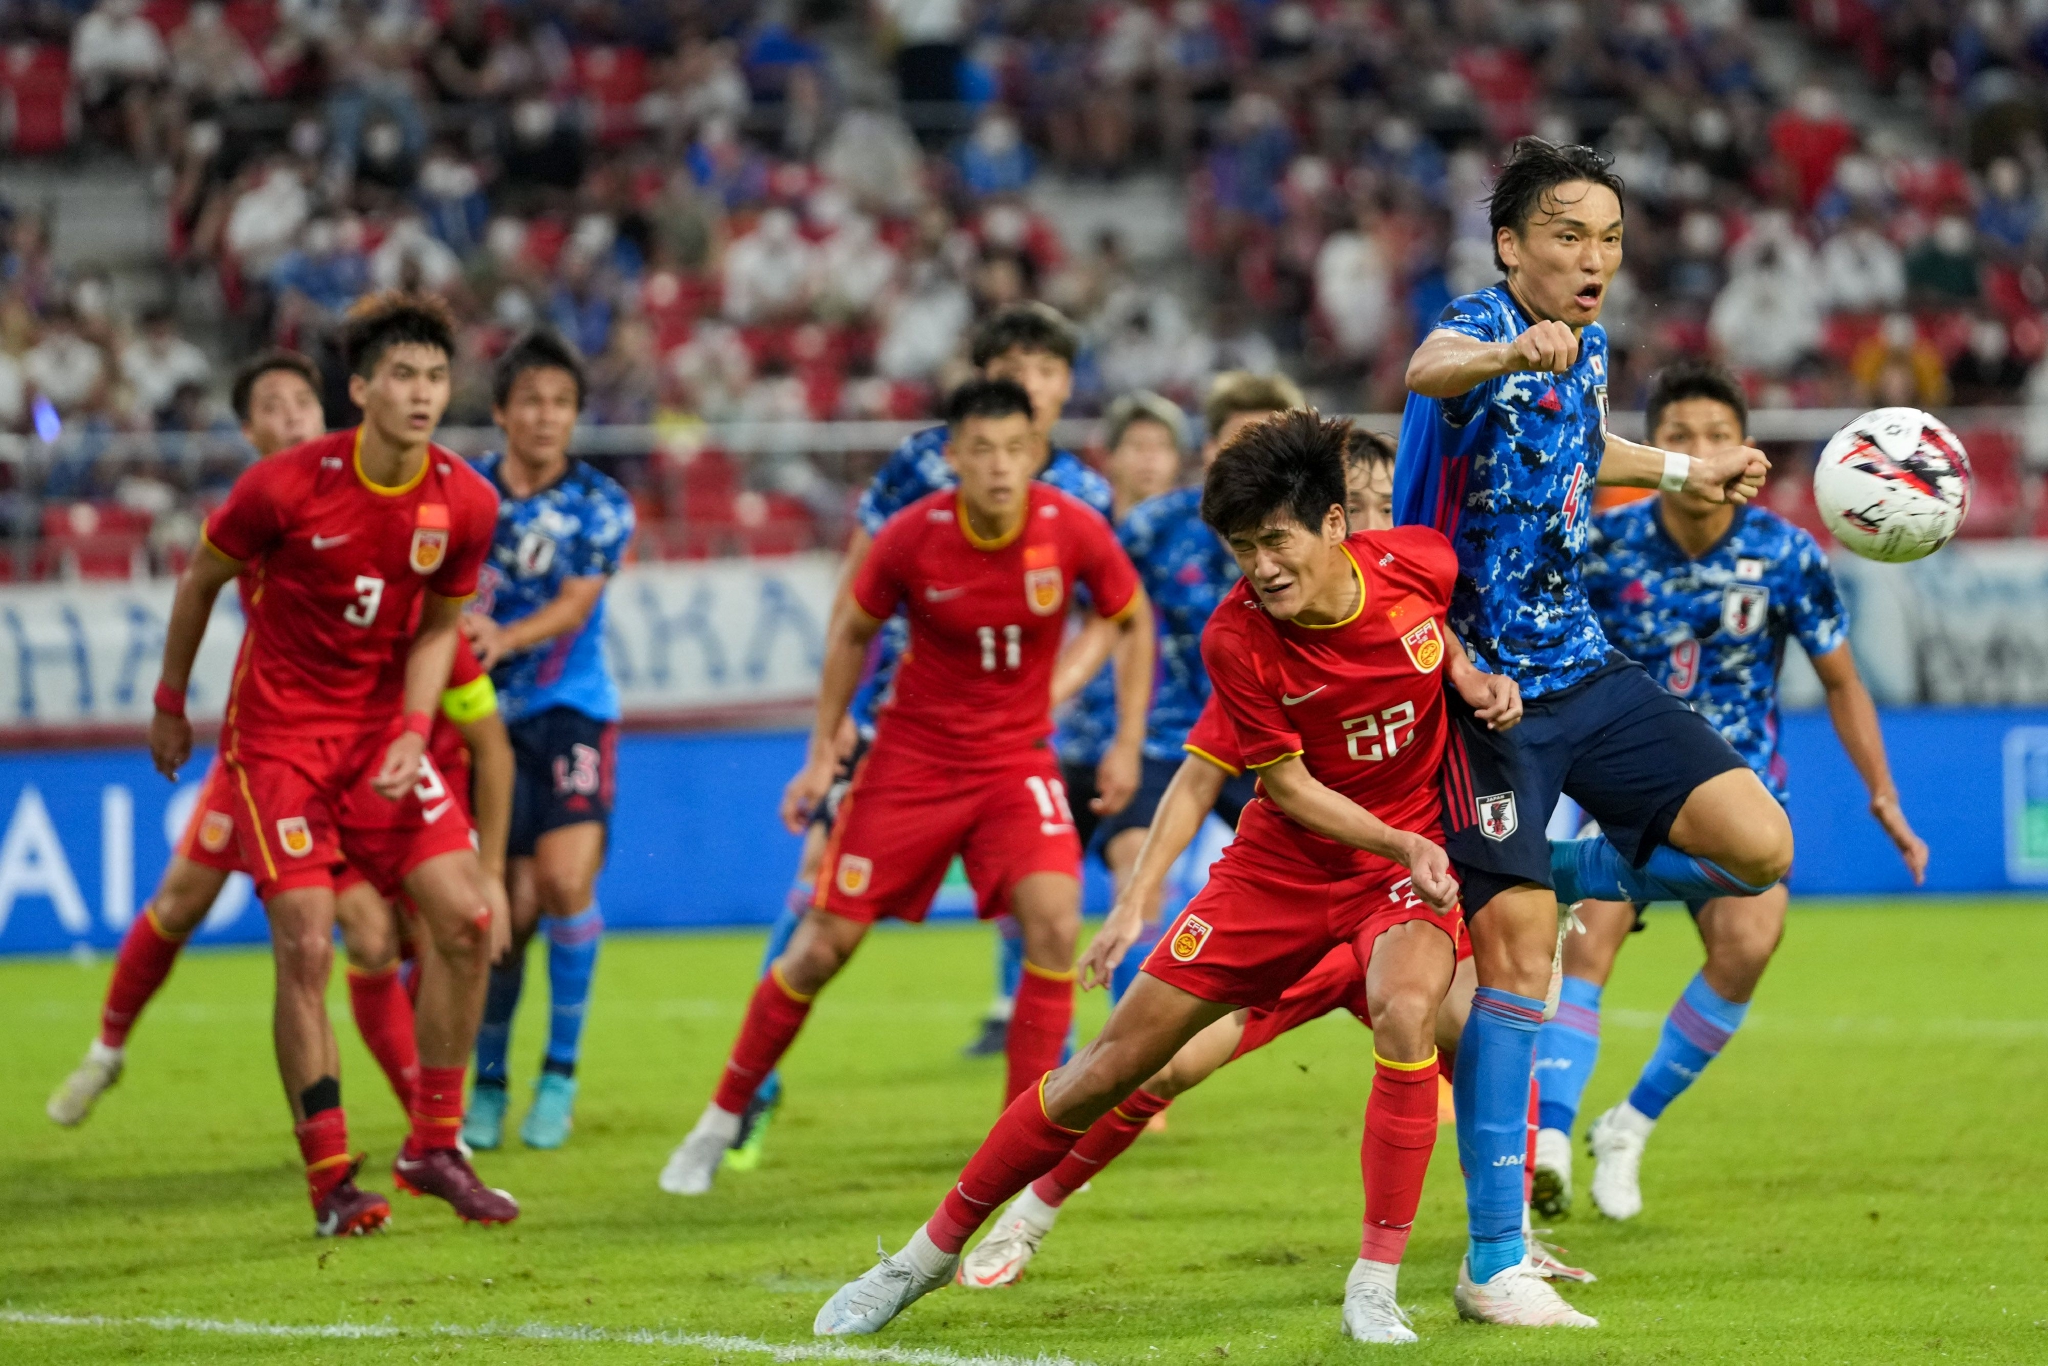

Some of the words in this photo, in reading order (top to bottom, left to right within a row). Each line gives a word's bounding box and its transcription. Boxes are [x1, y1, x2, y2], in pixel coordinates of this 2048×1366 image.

[1562, 462, 1584, 531] 4
[343, 574, 385, 629] 3
[977, 624, 1022, 671] 11
[1406, 622, 1433, 645] CFA
[1667, 639, 1700, 696] 9
[1341, 700, 1415, 761] 22
